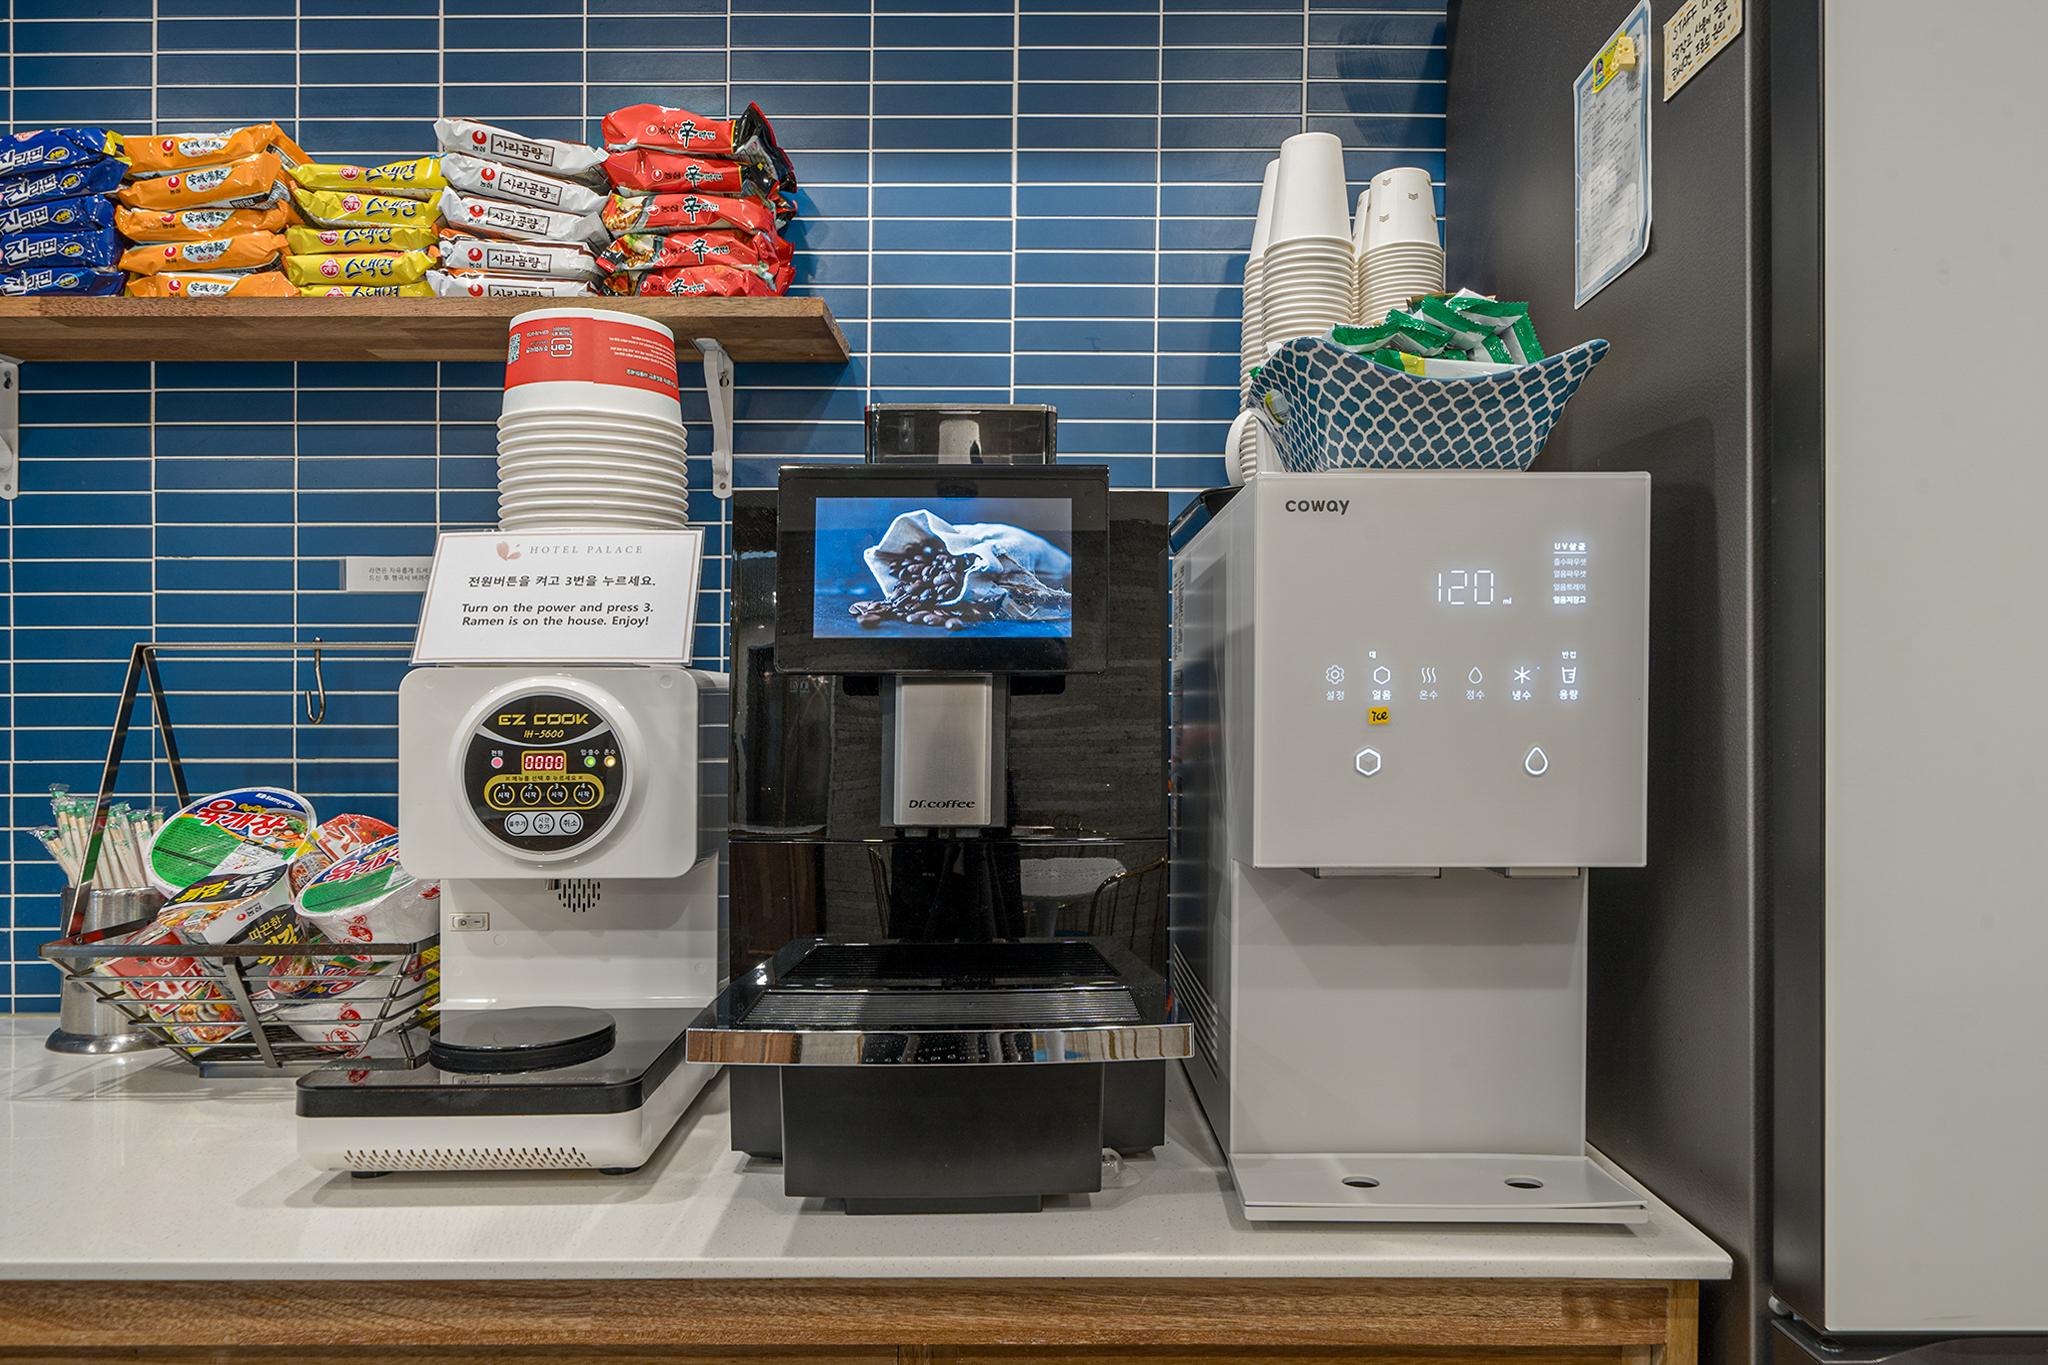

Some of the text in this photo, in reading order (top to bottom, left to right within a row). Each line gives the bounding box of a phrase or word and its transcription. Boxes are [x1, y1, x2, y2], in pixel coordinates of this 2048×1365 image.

[345, 258, 394, 279] 스낵면
[1285, 500, 1350, 515] coway
[529, 546, 643, 554] HOTEL PALACE
[468, 574, 656, 588] 전원버튼을 켜고 3번을 누르세요.
[1438, 570, 1494, 605] 120
[462, 602, 654, 615] Turn on the power and press 3.
[462, 616, 649, 628] Ramen is on the house. Enjoy!
[1372, 689, 1392, 701] 얼음
[1419, 689, 1438, 700] 온수
[1465, 689, 1485, 700] 정수
[1512, 689, 1531, 701] 냉수
[1559, 689, 1579, 701] 용량
[498, 713, 589, 726] EZ COOK
[523, 729, 564, 739] IH-5600
[525, 755, 564, 770] 0000
[909, 799, 976, 808] Dr.coffee
[196, 799, 288, 838] 육개장
[249, 914, 281, 941] 따끈한
